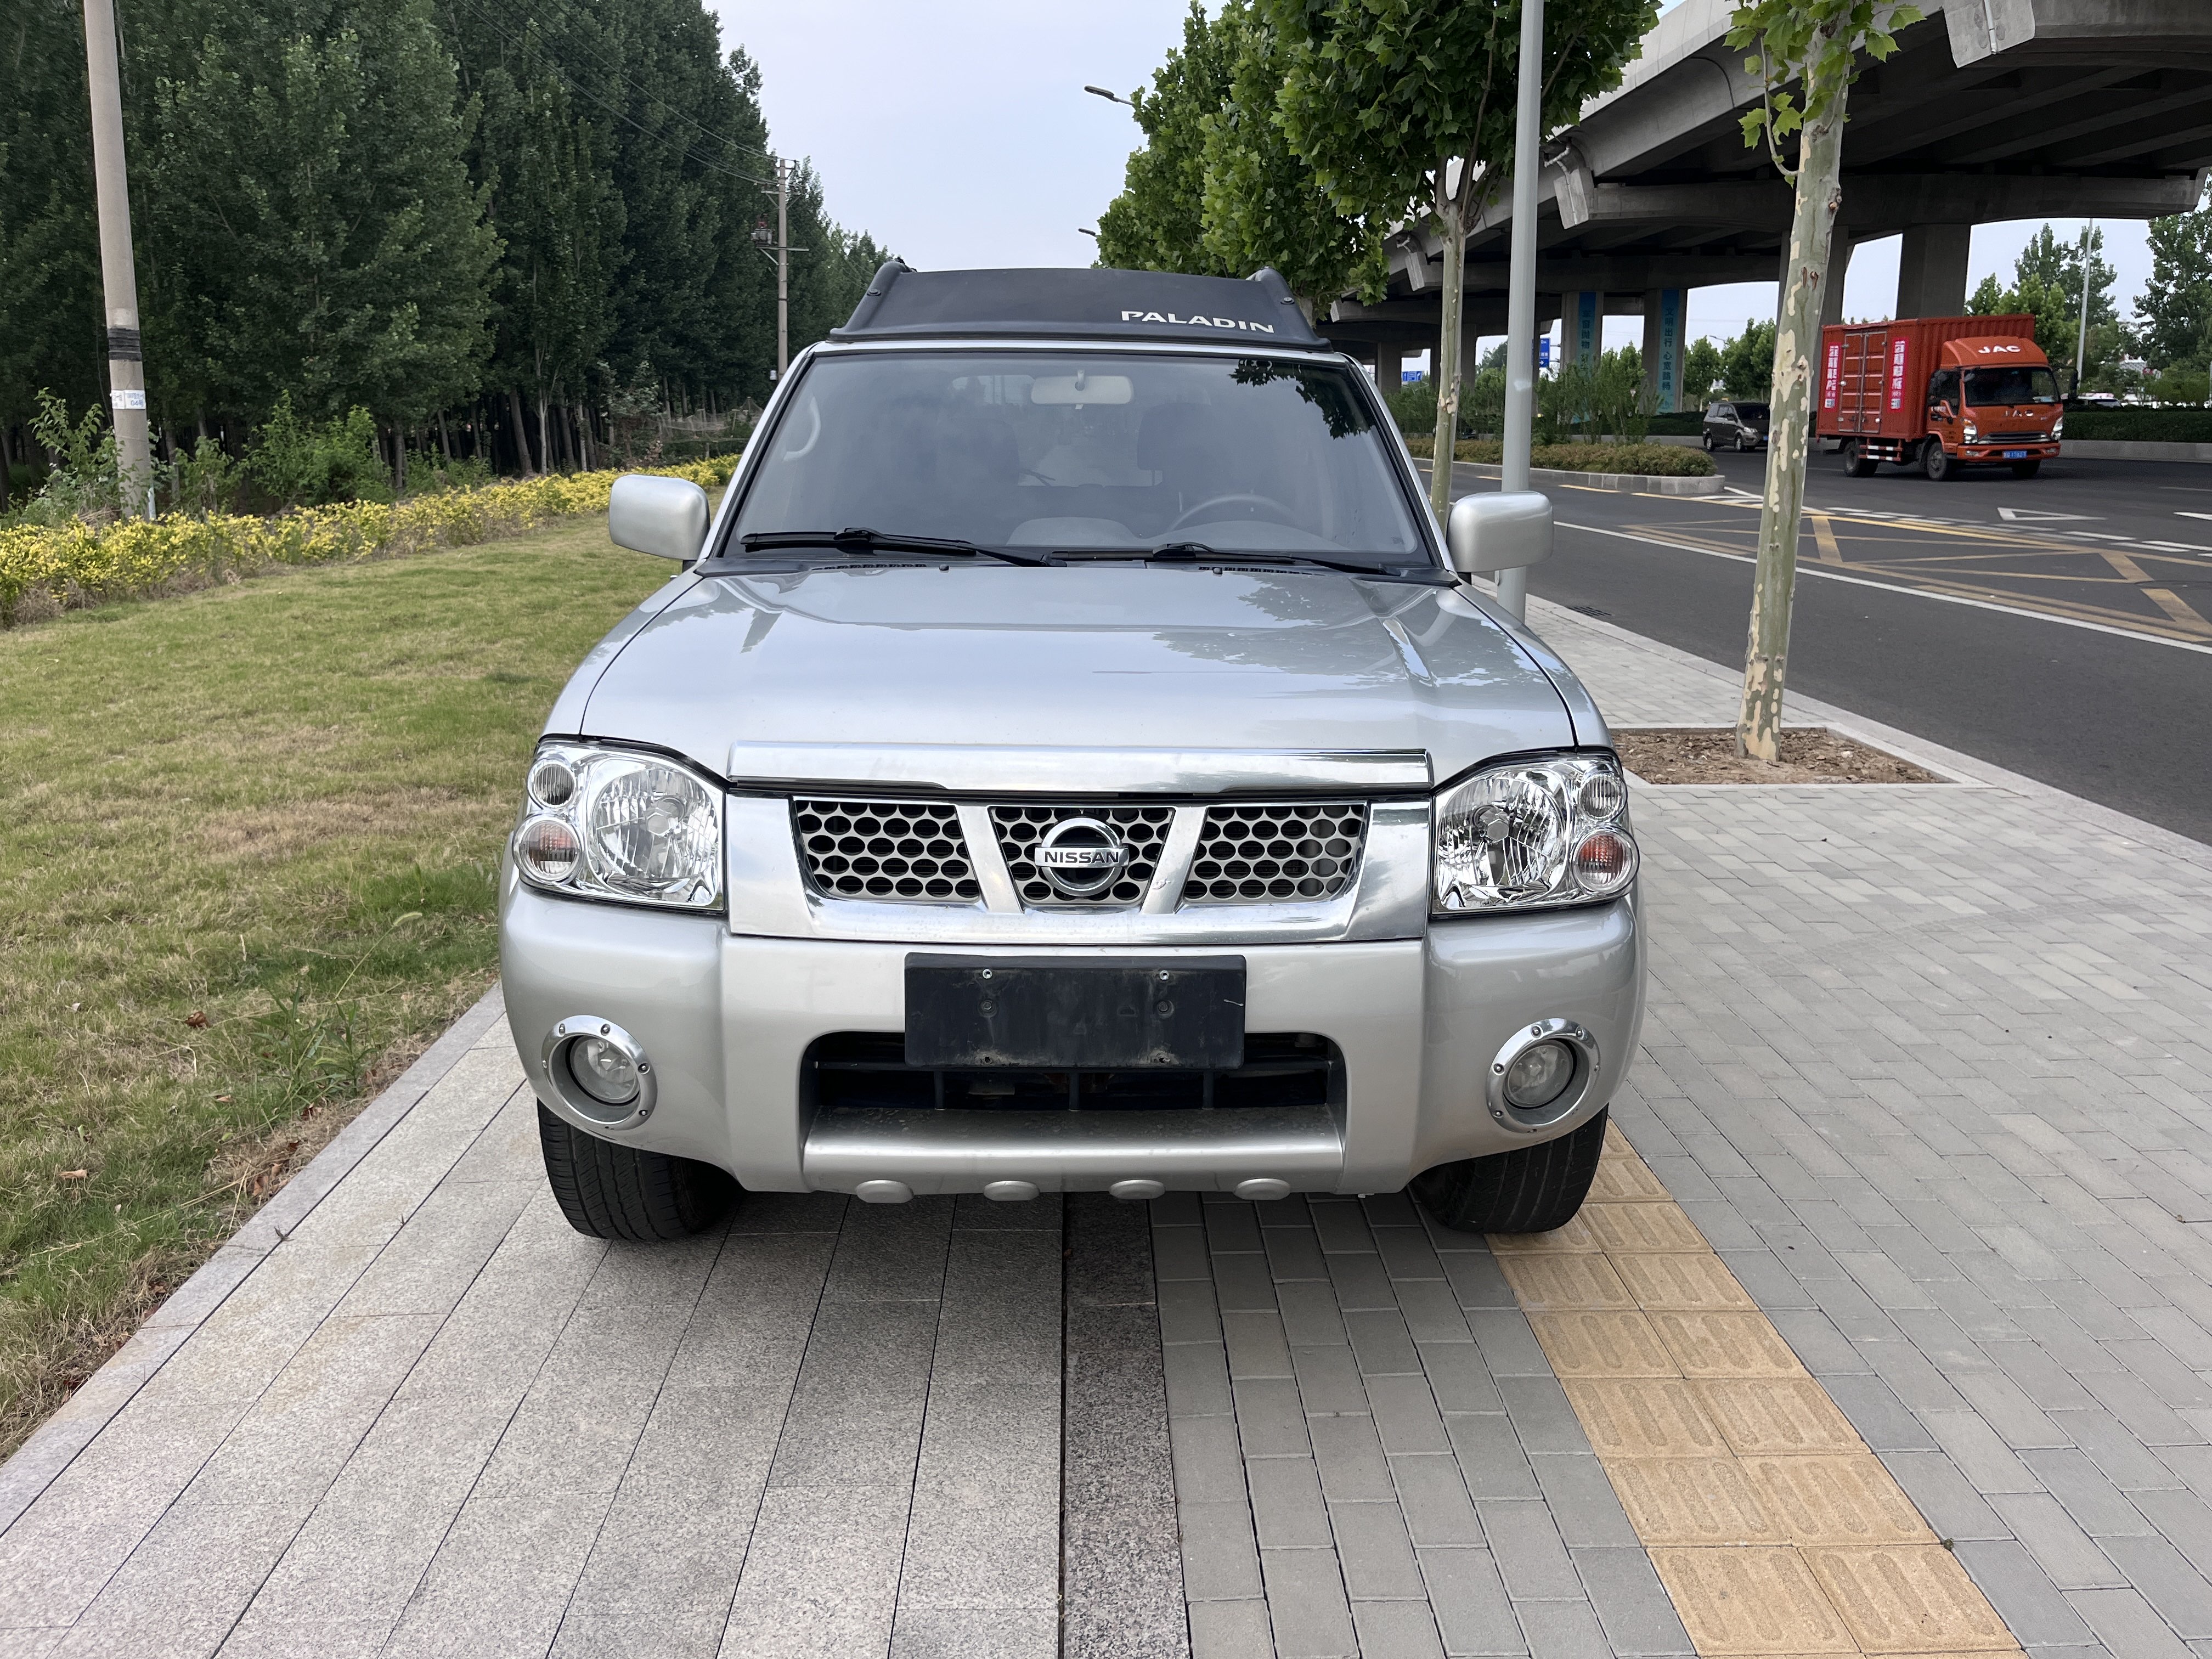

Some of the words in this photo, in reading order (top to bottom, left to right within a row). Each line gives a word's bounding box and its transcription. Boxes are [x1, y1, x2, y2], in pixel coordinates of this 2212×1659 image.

[1121, 311, 1275, 333] PALADIN
[1664, 308, 1674, 347] 文明出行
[1978, 345, 2021, 354] JAC
[1045, 851, 1118, 863] NISSAN
